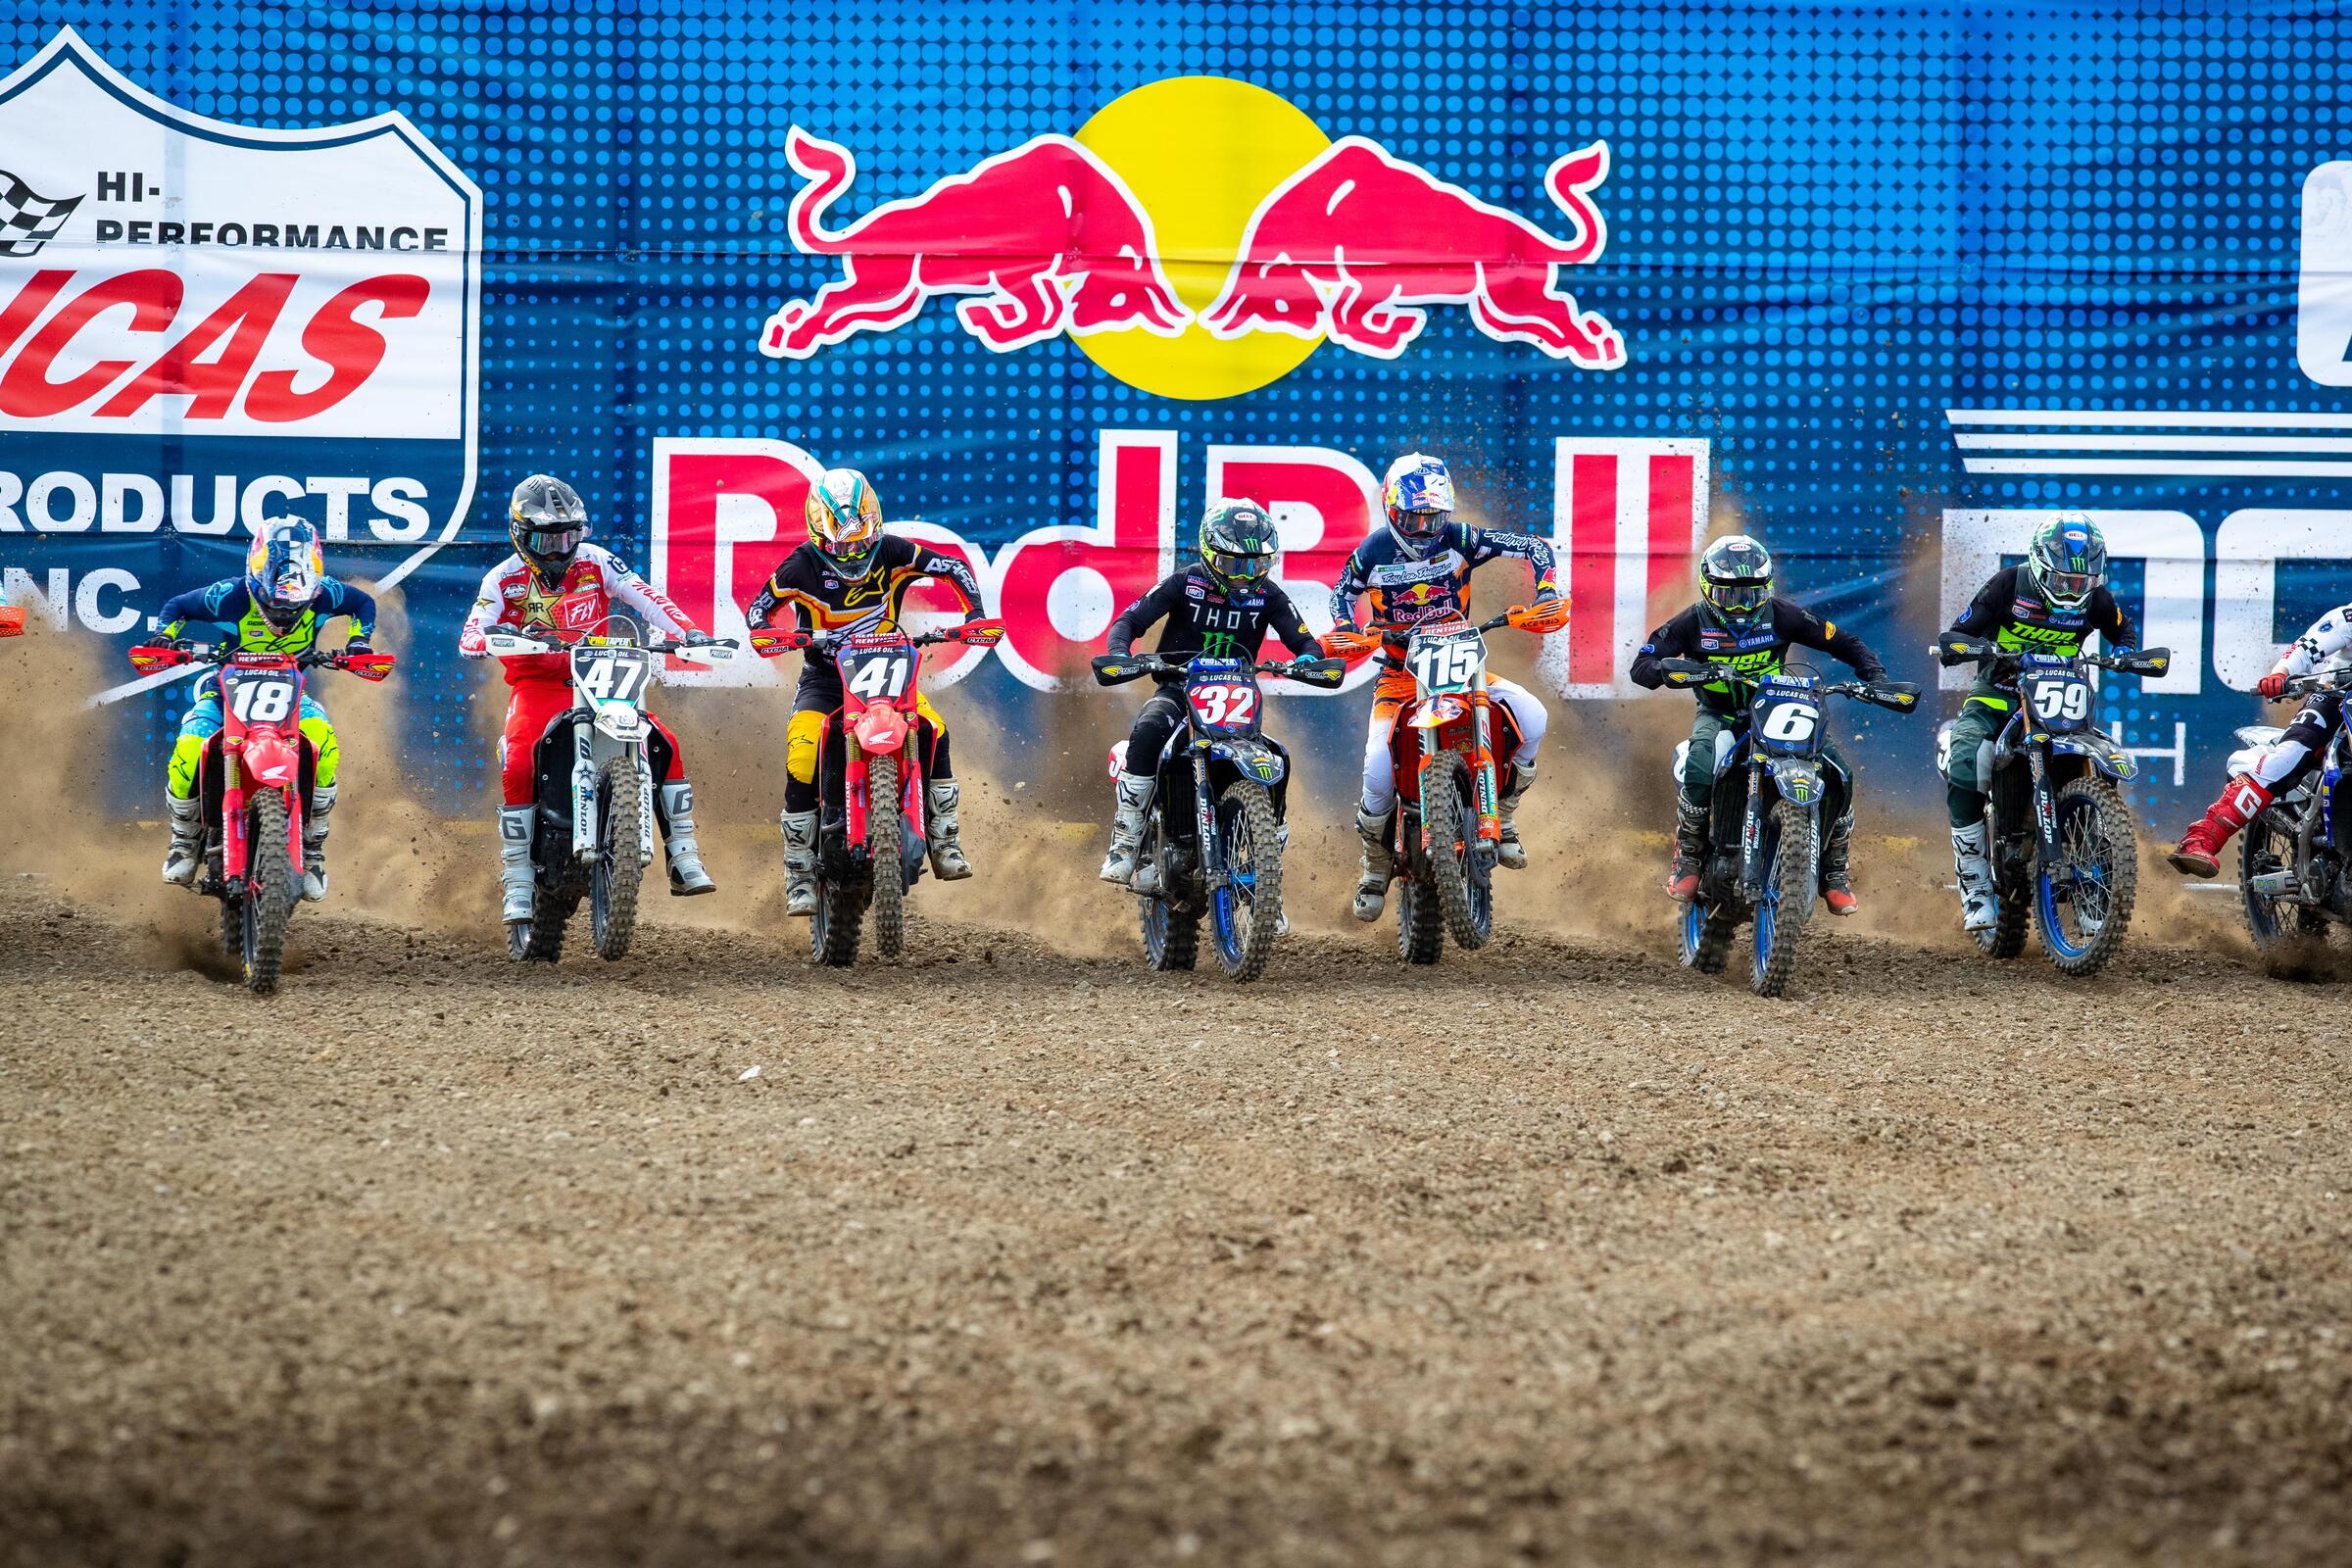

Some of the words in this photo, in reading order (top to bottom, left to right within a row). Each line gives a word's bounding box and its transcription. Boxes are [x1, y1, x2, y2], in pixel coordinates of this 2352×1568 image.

[98, 172, 160, 202] HI-
[98, 220, 448, 251] PERFORMANCE
[1382, 573, 1401, 584] Troy
[1402, 571, 1417, 581] Lee
[1417, 563, 1451, 578] Designs
[570, 598, 596, 623] FLY
[1393, 606, 1425, 622] Red
[1425, 598, 1453, 619] Bull
[1520, 618, 1560, 628] ACERBIS
[590, 637, 630, 646] PROTAPER
[1746, 635, 1775, 647] YAMAHA
[2011, 621, 2077, 644] THOR
[1332, 645, 1372, 656] ACERBIS
[1413, 642, 1478, 686] 115
[582, 659, 644, 700] 47
[850, 658, 908, 698] 41
[232, 680, 293, 722] 18
[1196, 686, 1254, 725] 32
[2034, 681, 2087, 720] 59
[1763, 703, 1819, 741] 6
[1200, 798, 1211, 852] DUNLOP
[2040, 790, 2053, 844] DUNLOP
[1745, 810, 1754, 864] DUNLOP
